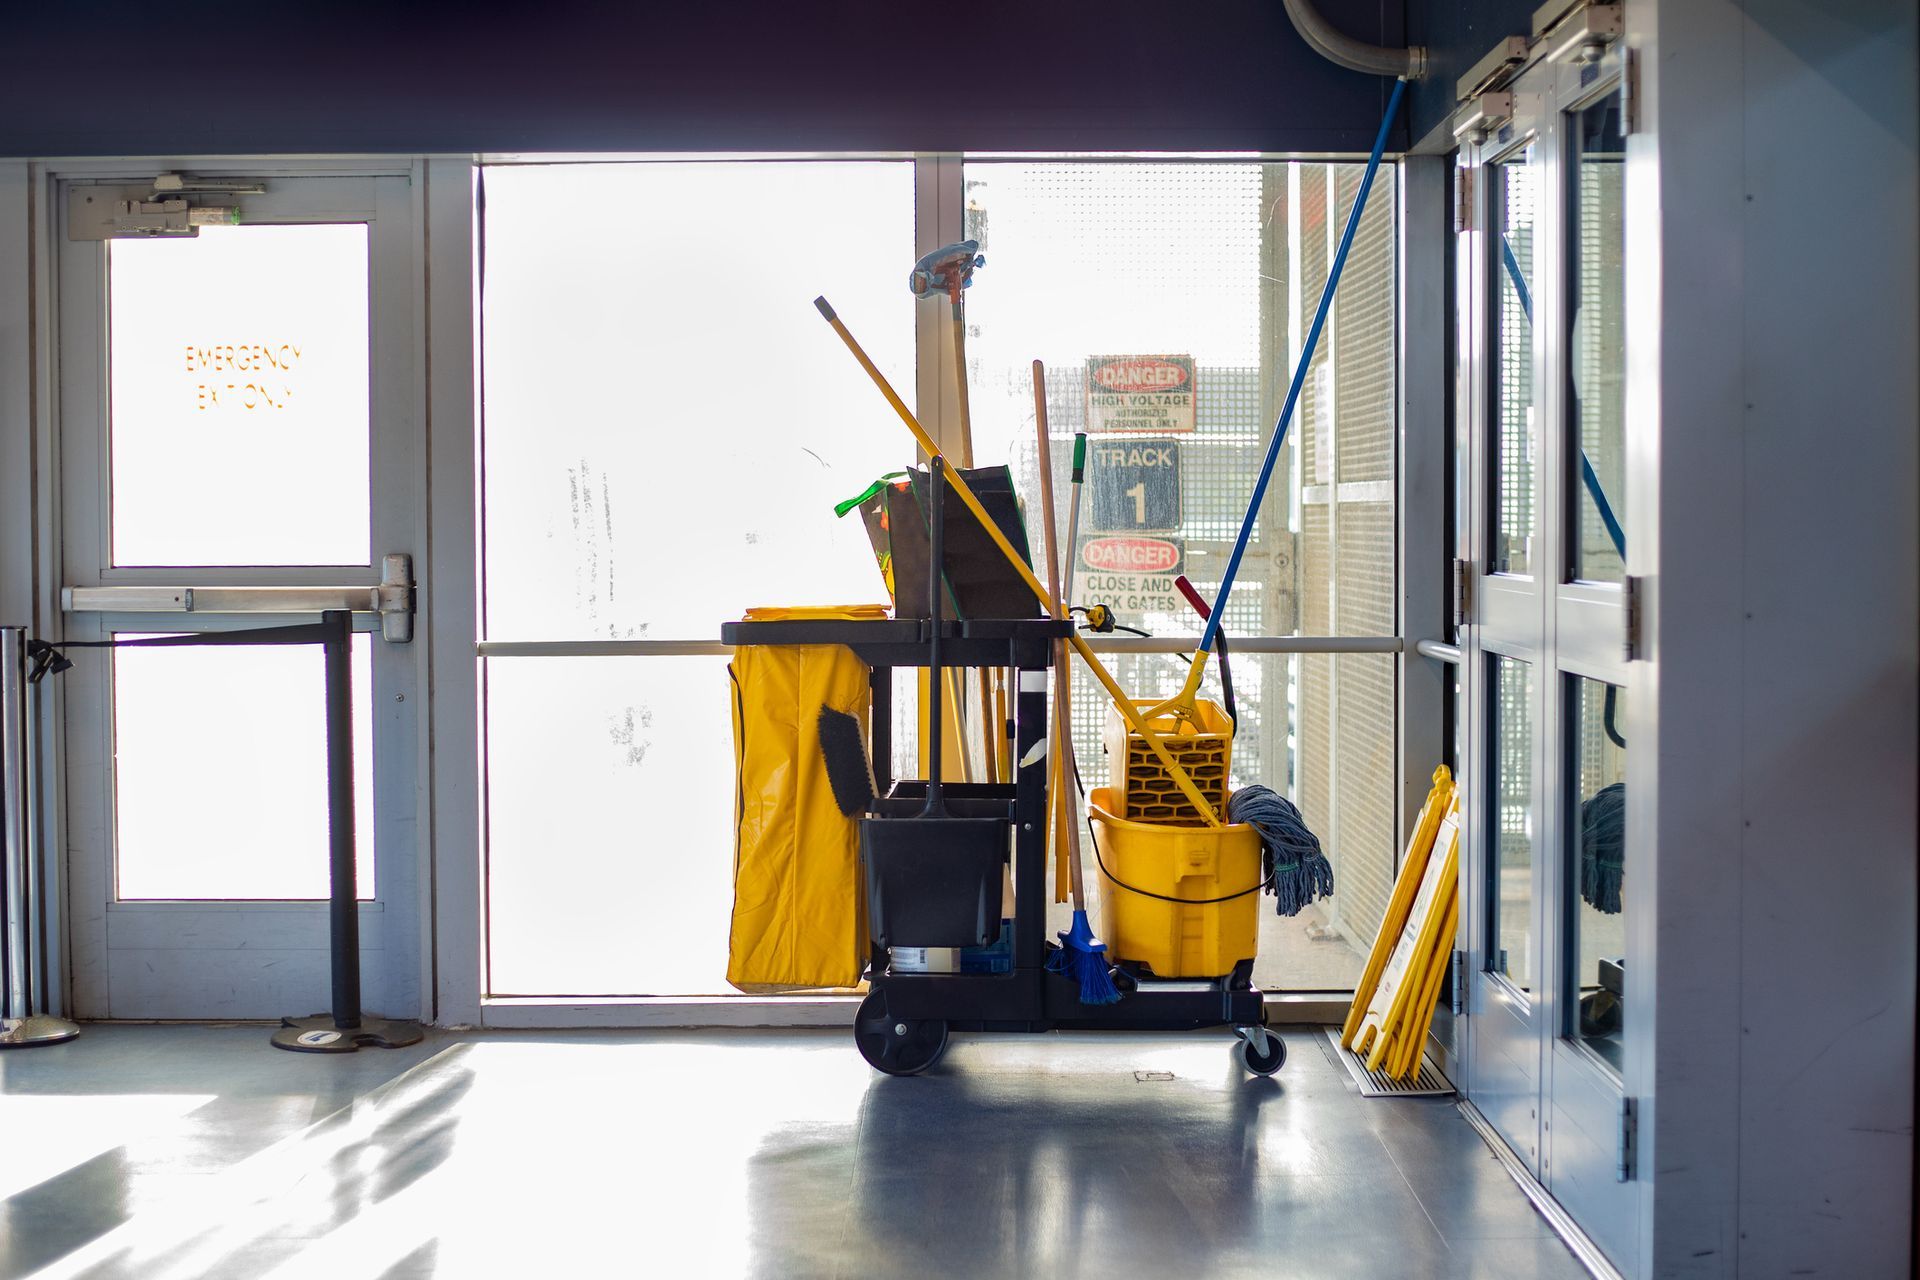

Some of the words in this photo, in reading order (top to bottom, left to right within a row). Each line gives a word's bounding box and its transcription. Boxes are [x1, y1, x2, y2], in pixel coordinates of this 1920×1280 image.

[186, 345, 302, 371] EMERGENCY
[1102, 367, 1180, 385] DANGER
[198, 384, 235, 410] EX
[244, 384, 292, 409] ON
[1091, 395, 1124, 406] HIGH
[1129, 395, 1190, 405] VOLTAGE
[1116, 409, 1168, 417] AUTHORIZED
[1104, 419, 1152, 428] PERSONNEL
[1156, 420, 1178, 428] ONLY
[1096, 448, 1173, 467] TRACK
[1126, 481, 1146, 524] 1
[1088, 544, 1171, 565] DANGER
[1087, 576, 1136, 592] CLOSE
[1141, 578, 1172, 593] AND
[1083, 594, 1122, 609] LOCK
[1127, 595, 1176, 611] GATES
